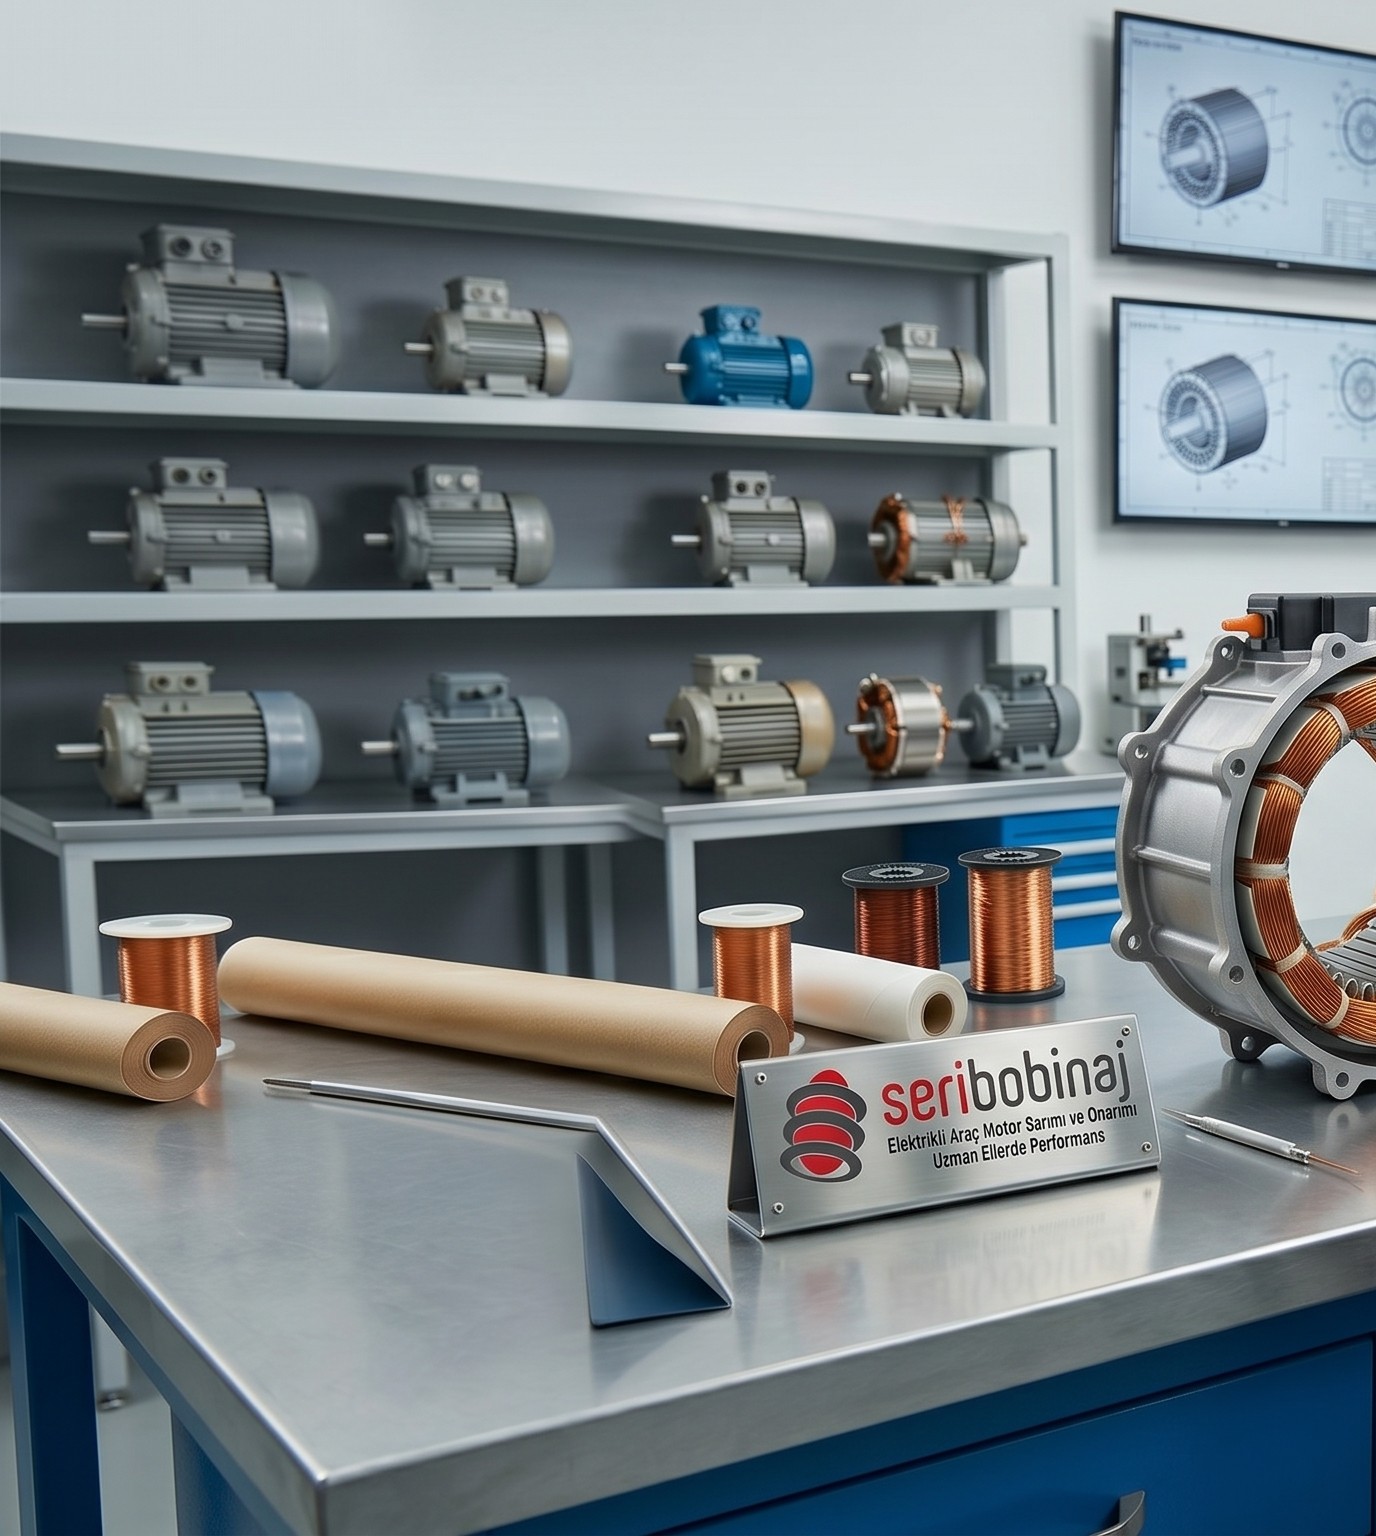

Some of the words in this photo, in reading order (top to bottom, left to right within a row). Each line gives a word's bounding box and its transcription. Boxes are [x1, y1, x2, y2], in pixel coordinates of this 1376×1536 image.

[882, 1039, 1130, 1126] seribobinaj
[888, 1129, 946, 1154] Elektrikli
[950, 1127, 980, 1145] Araç
[983, 1120, 1021, 1139] Motor
[1025, 1114, 1066, 1132] Sarımı
[1069, 1111, 1085, 1125] ve
[1088, 1104, 1138, 1122] Onarımı
[933, 1151, 979, 1169] Uzman
[981, 1139, 1026, 1161] Ellerde
[1030, 1130, 1106, 1153] Performans
